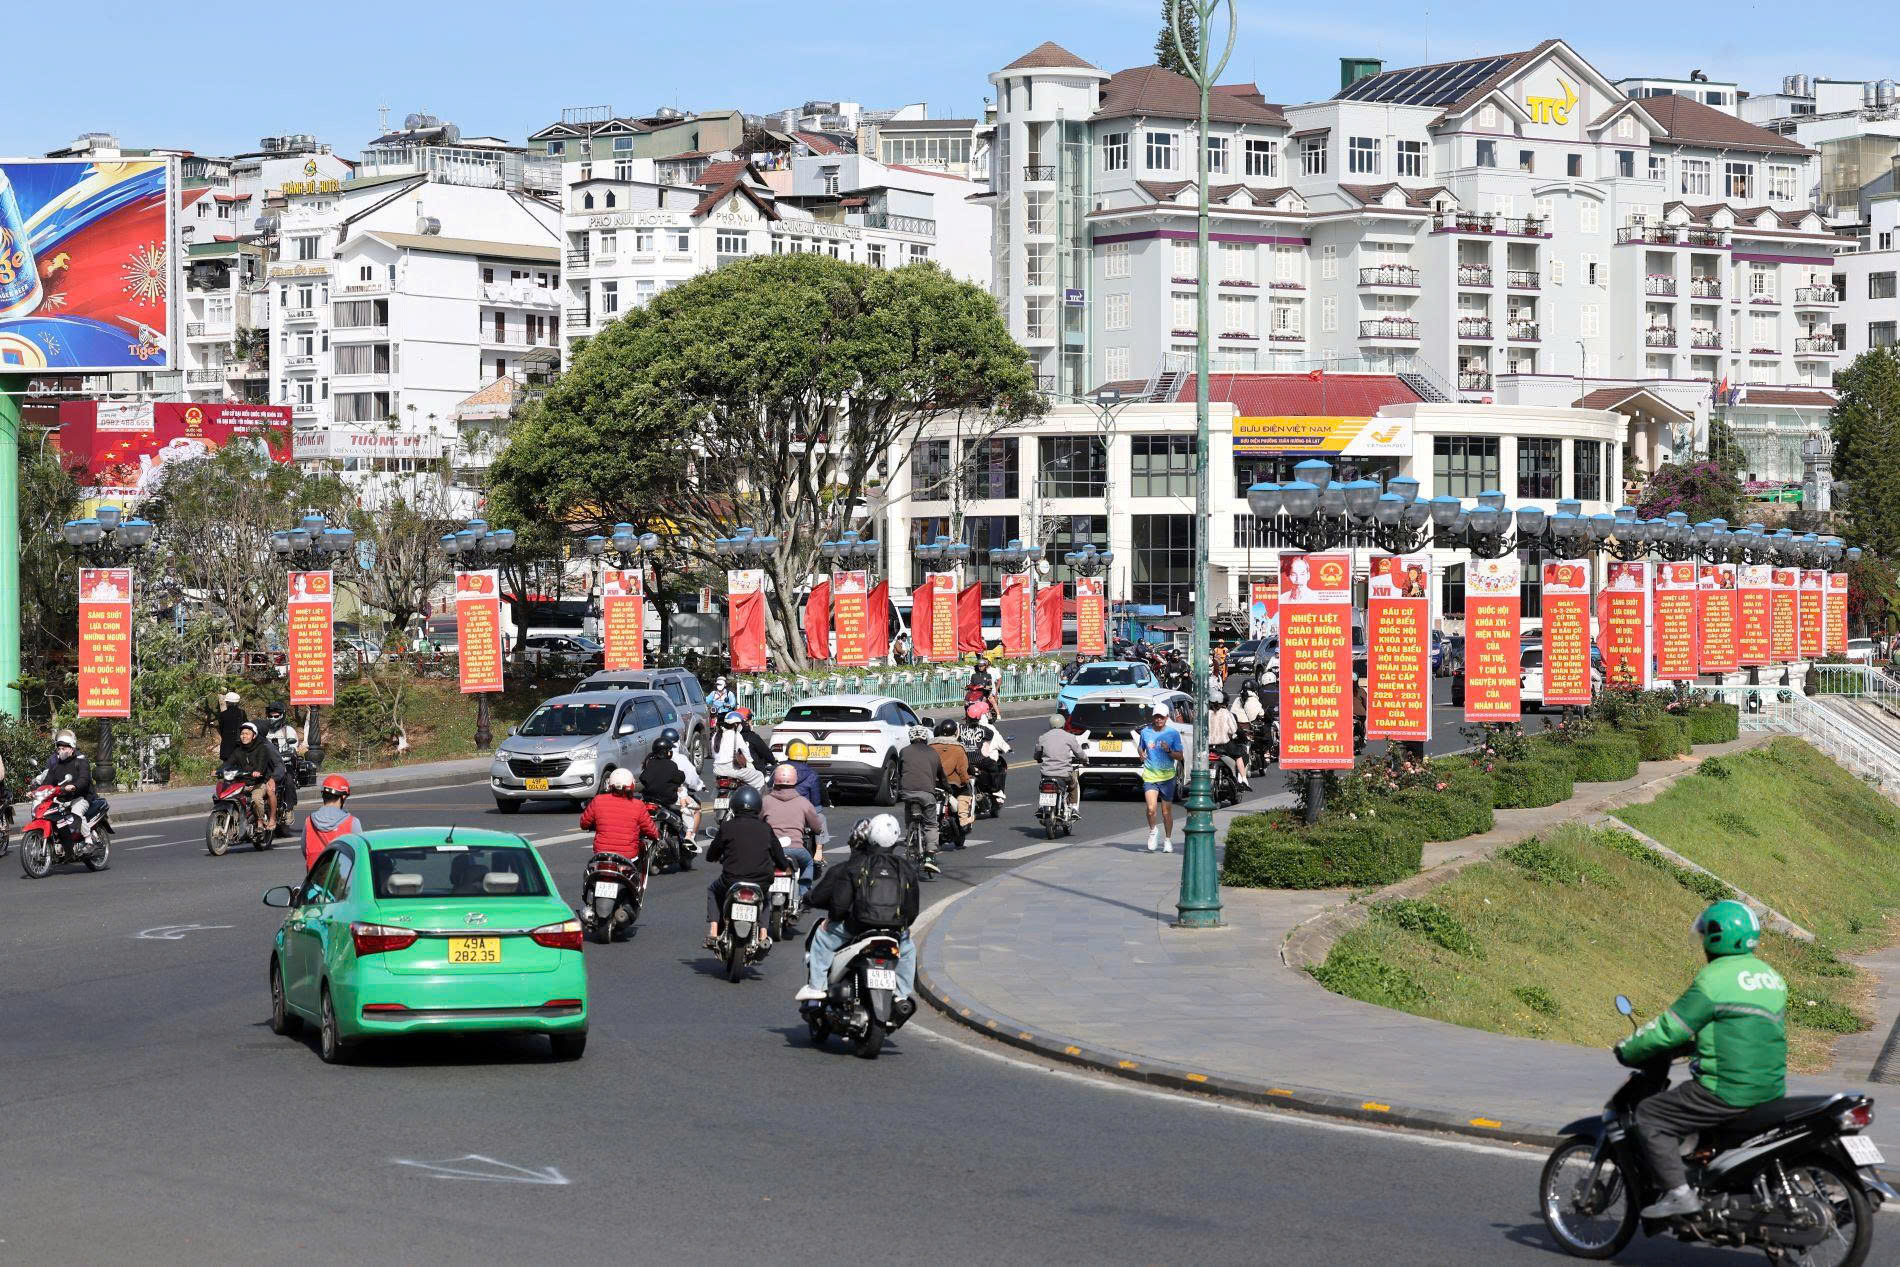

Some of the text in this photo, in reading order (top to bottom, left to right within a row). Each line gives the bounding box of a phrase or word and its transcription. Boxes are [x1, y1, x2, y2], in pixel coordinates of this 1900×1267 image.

[1526, 96, 1569, 125] TTC
[320, 179, 340, 192] HOTEL
[638, 212, 679, 224] HOTEL
[128, 345, 160, 360] Tiger
[1262, 424, 1284, 434] ĐIỆN
[1286, 424, 1306, 434] VIỆT
[1373, 587, 1390, 596] XVI
[1291, 613, 1337, 623] NHIỆT LIỆT
[1288, 625, 1341, 634] CHÀO MỪNG
[1403, 626, 1416, 635] HỘI
[1285, 636, 1345, 646] NGÀY BẦU CỬ
[1296, 648, 1334, 658] ĐẠI BIỂU
[1402, 644, 1421, 652] BIỂU
[1378, 654, 1392, 662] HỘI
[1294, 660, 1336, 670] QUỐC HỘI
[1295, 673, 1336, 682] KHÓA XVI
[1290, 684, 1341, 694] VÀ ĐẠI BIỂU
[1294, 696, 1337, 706] HỘI ĐỒNG
[1408, 700, 1422, 709] HỘI
[1292, 708, 1339, 717] NHÂN DÂN
[1296, 720, 1335, 729] CÁC CẤP
[1294, 732, 1337, 741] NHIỆM KỲ
[464, 938, 485, 949] 49A
[455, 950, 495, 961] 282.35
